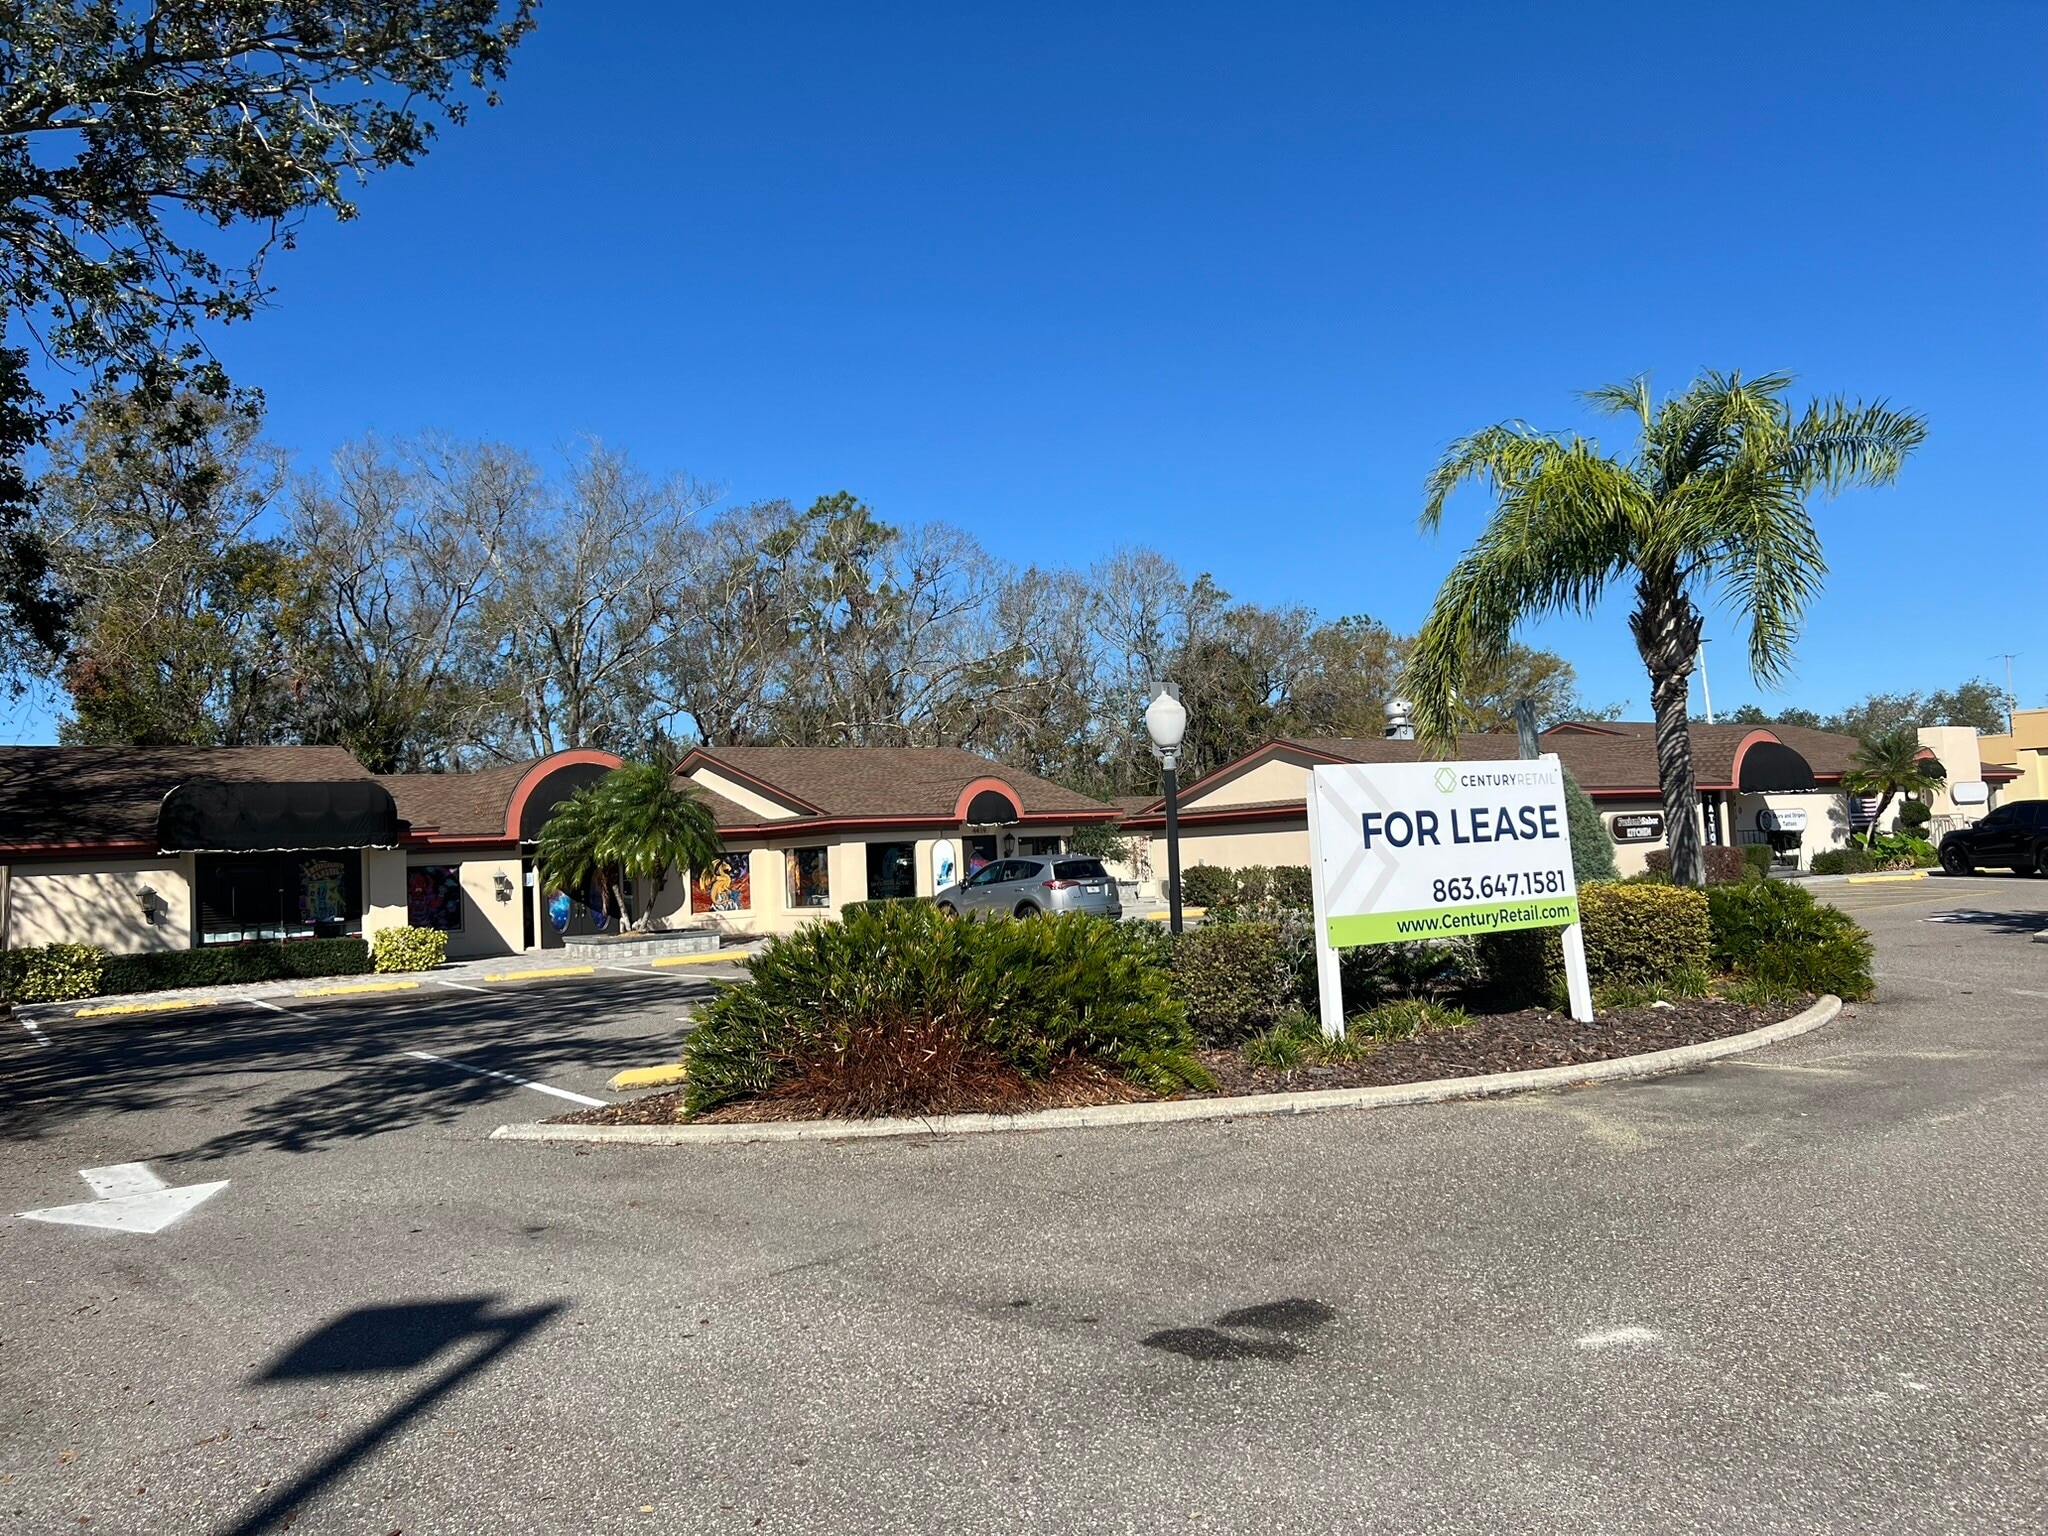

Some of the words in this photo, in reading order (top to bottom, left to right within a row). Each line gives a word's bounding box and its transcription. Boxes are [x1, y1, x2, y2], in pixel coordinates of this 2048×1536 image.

[1361, 810, 1441, 849] FOR
[1450, 804, 1560, 844] LEASE
[1432, 869, 1566, 902] 863.647.1581
[1396, 904, 1570, 934] www.CenturyRetail.com
